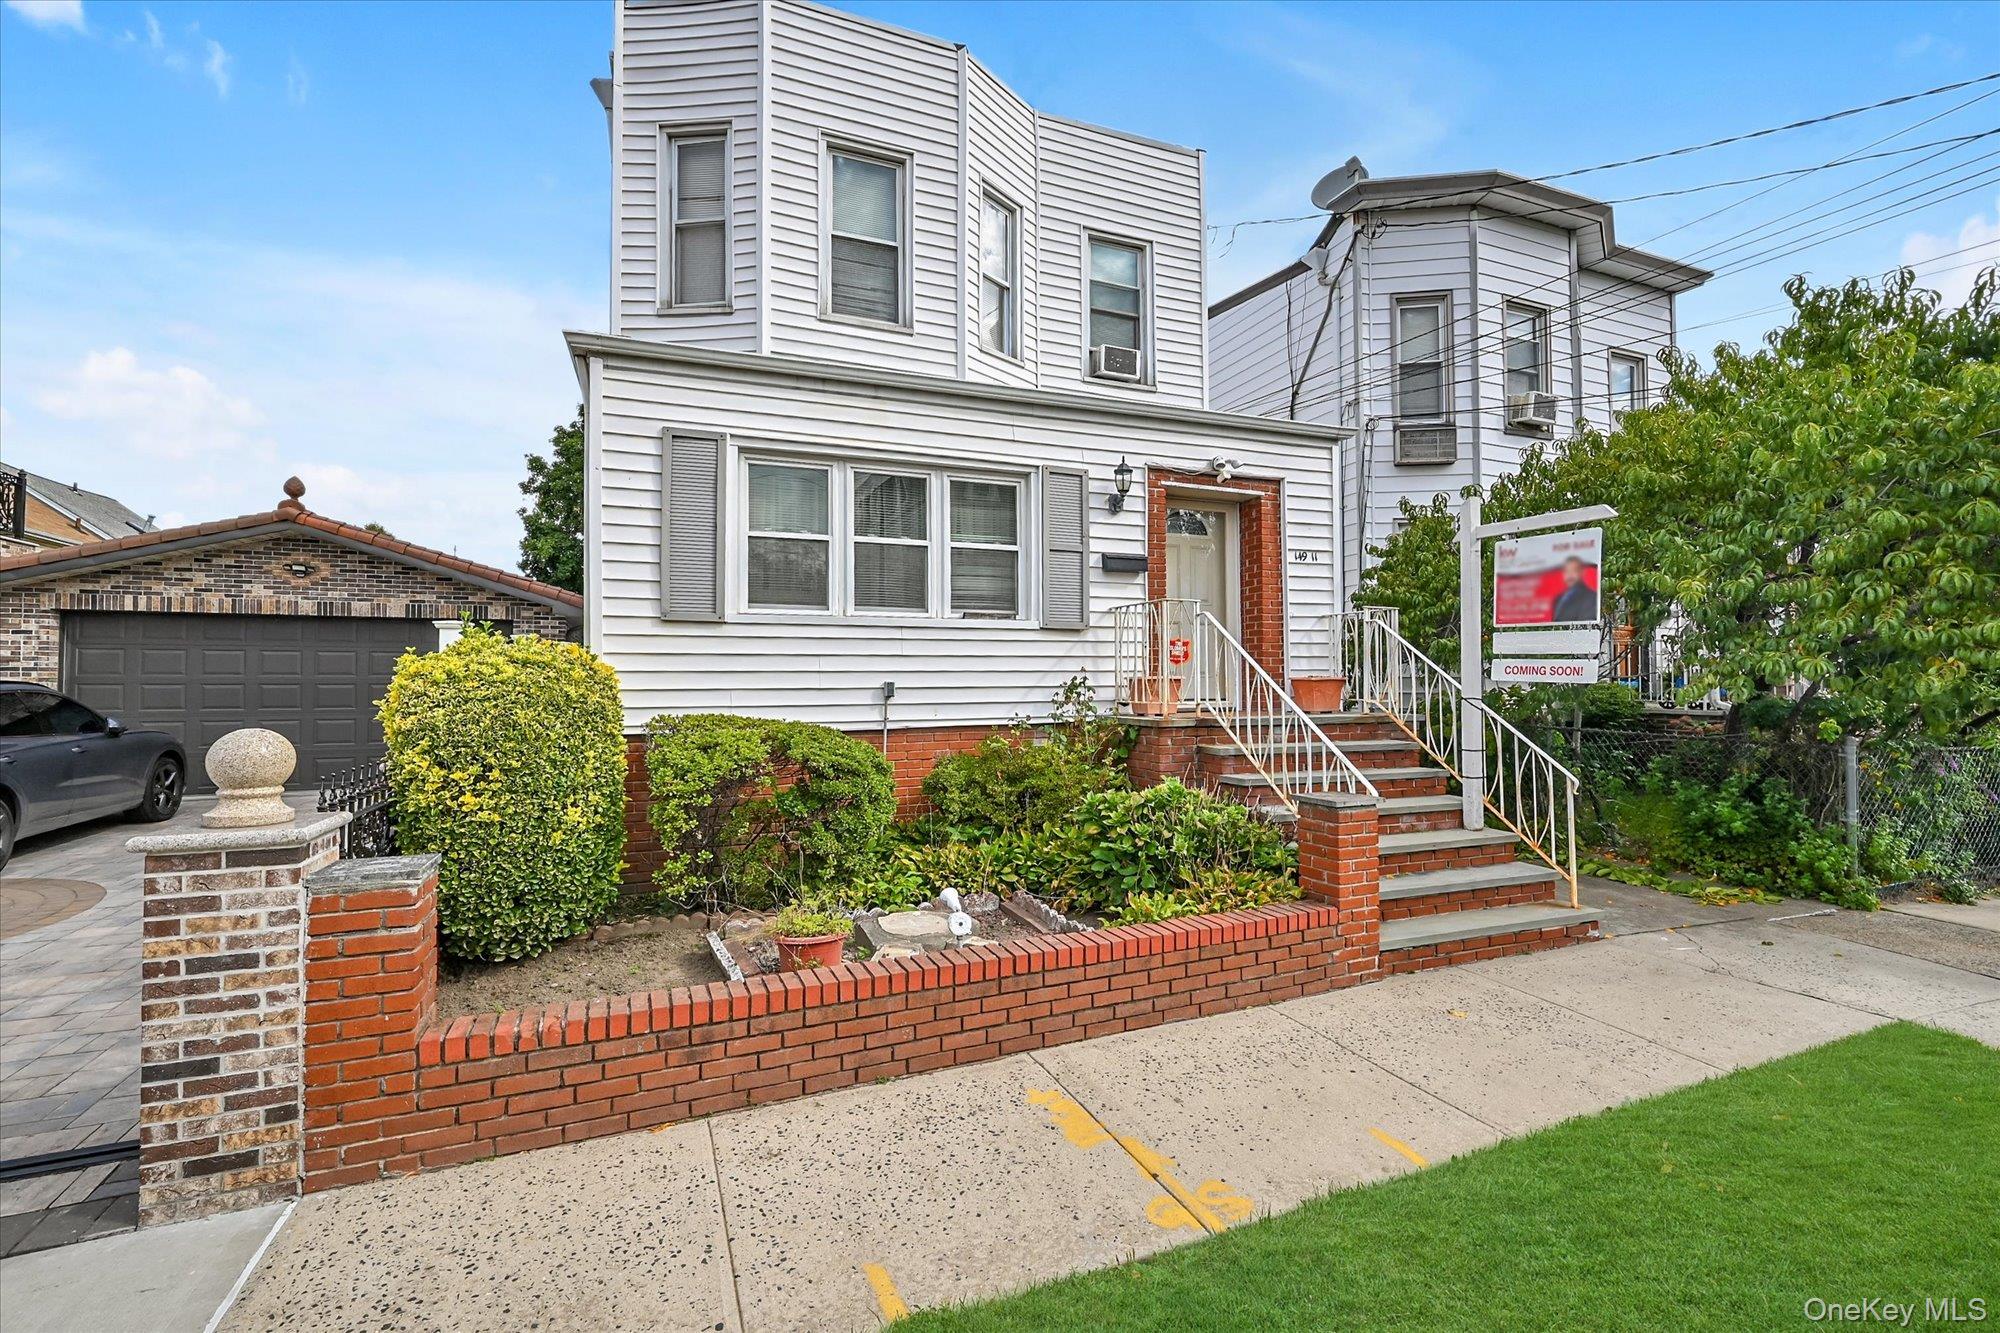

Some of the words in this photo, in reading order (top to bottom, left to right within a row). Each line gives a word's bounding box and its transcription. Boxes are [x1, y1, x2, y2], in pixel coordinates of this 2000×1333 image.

[1294, 551, 1308, 562] 149
[1311, 552, 1318, 562] 11
[1504, 665, 1547, 676] COMING
[1549, 666, 1584, 677] SOON!
